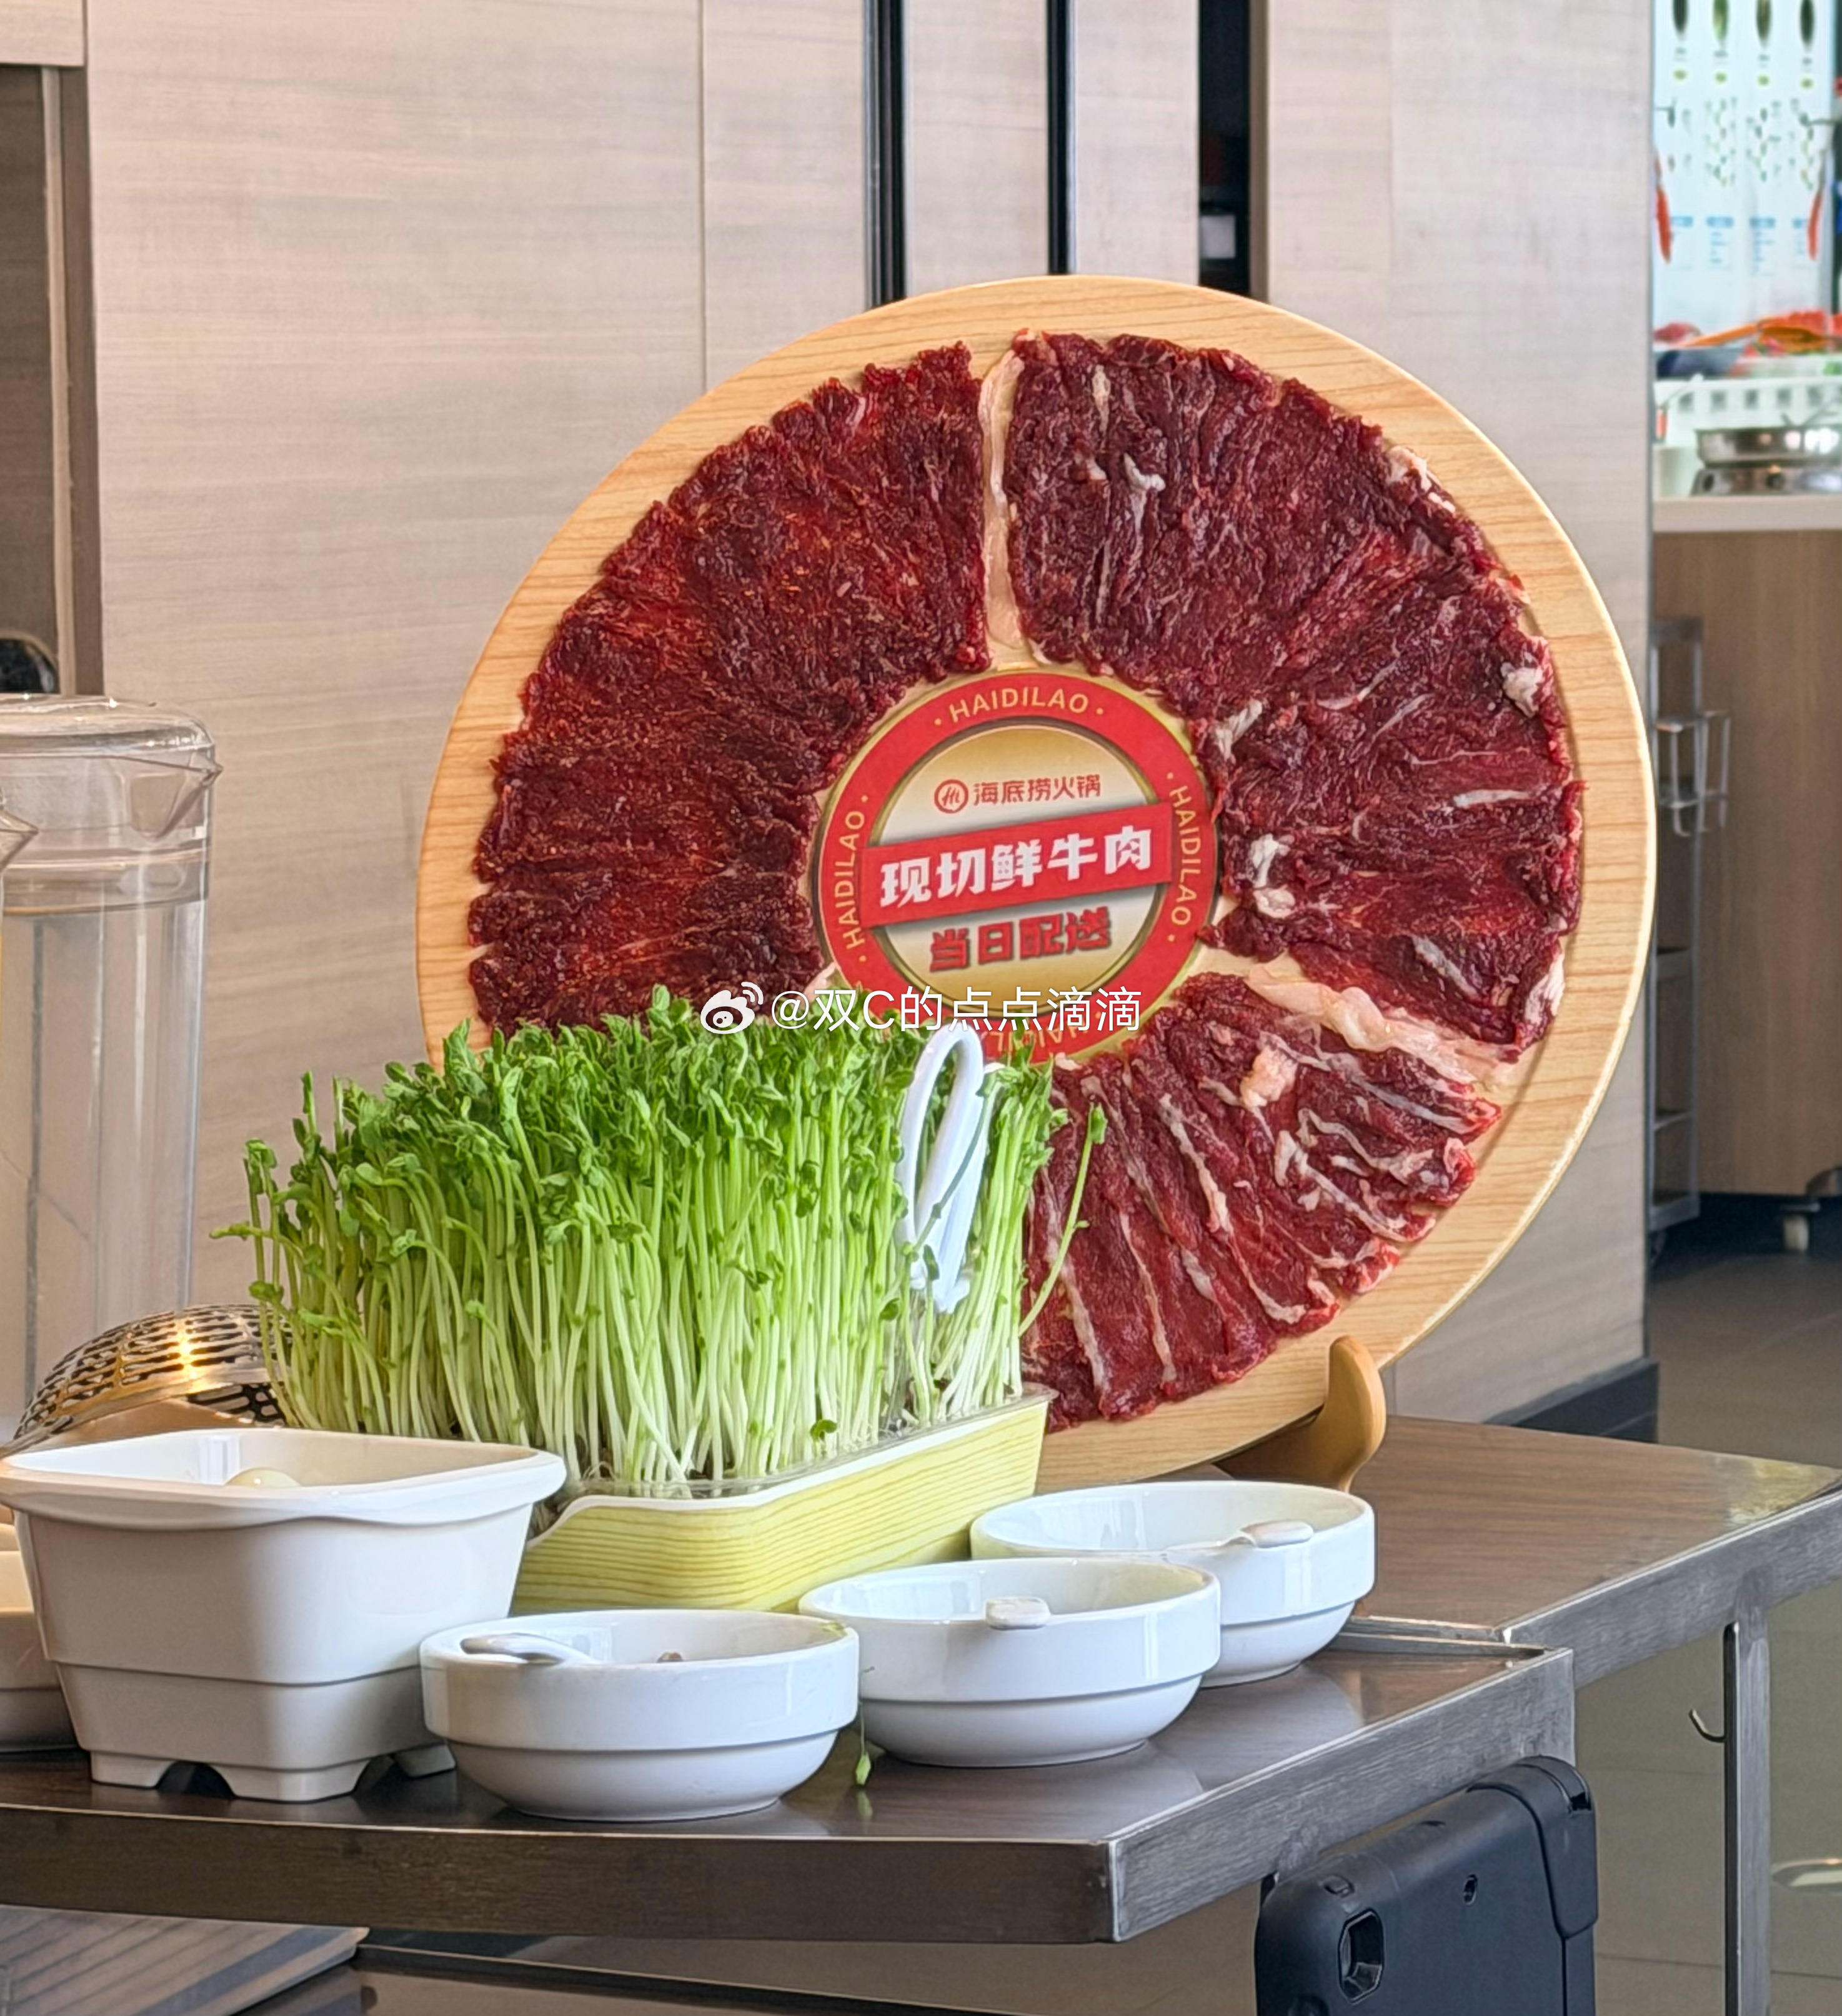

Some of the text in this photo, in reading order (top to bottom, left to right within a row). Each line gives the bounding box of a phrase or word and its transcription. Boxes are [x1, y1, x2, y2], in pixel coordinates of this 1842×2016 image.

[949, 687, 1088, 722] HAIDILAO
[973, 774, 1101, 806] 海底捞火锅
[834, 811, 865, 949] HAIDILAO
[880, 825, 1152, 908] 现切鲜牛肉
[1169, 786, 1201, 925] HAIDILAO
[929, 906, 1111, 973] 当日配送
